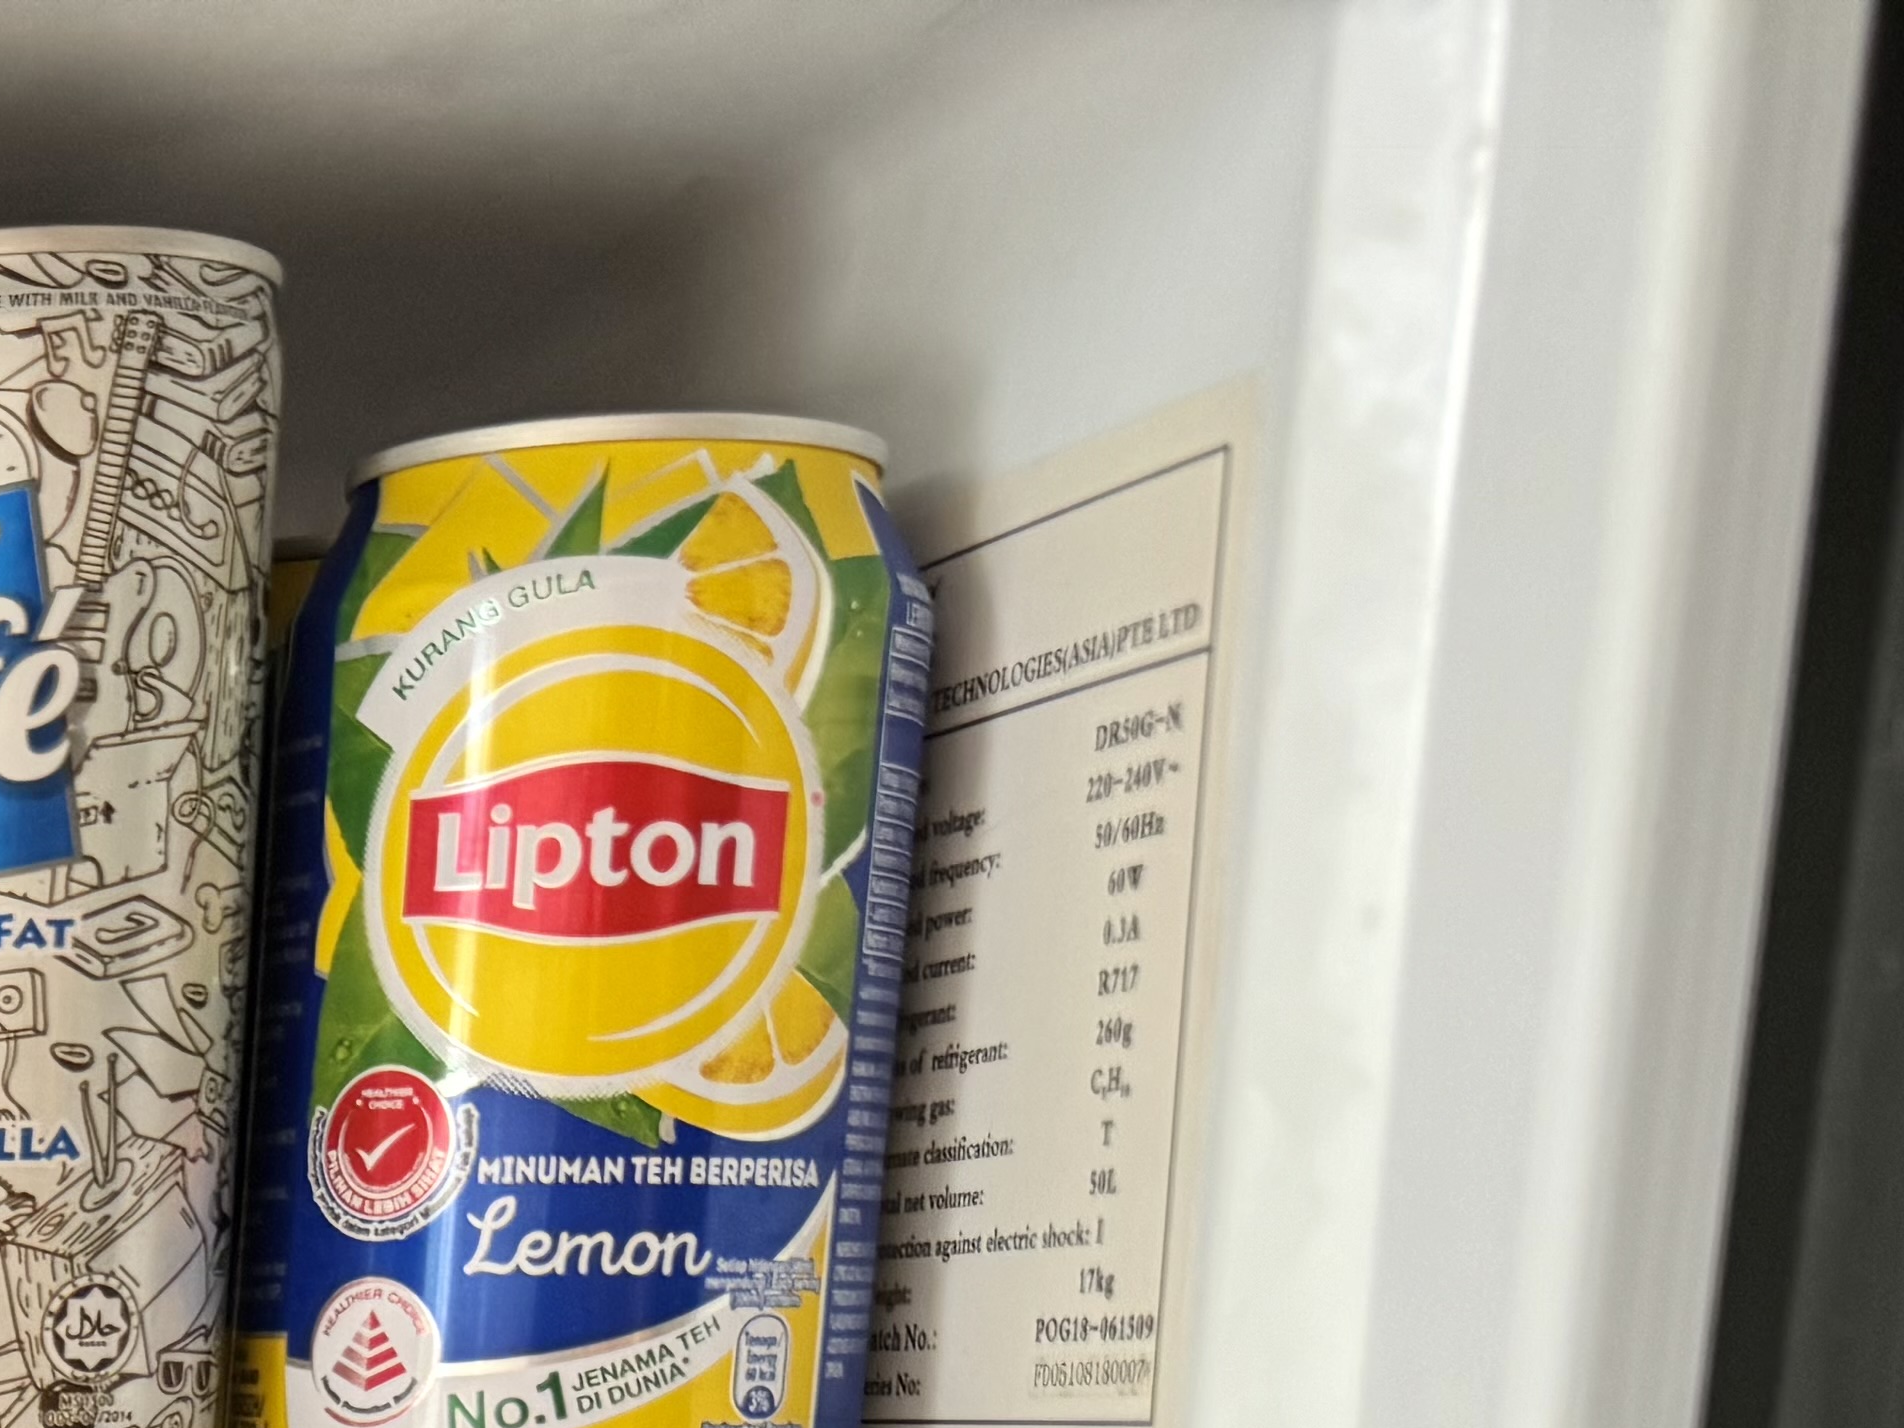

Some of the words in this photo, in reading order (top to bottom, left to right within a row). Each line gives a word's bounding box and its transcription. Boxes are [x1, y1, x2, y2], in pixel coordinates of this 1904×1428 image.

[7, 292, 54, 309] WITH
[58, 290, 98, 307] MILK
[105, 291, 139, 307] AND
[392, 600, 500, 701] KURANG
[507, 569, 596, 608] GULA
[433, 802, 756, 911] Lipton
[1107, 862, 1146, 897] 60W
[1097, 962, 1140, 997] R717
[1095, 1015, 1135, 1050] 260g
[477, 1155, 625, 1186] MINUMAN
[631, 1156, 684, 1185] TEH
[689, 1156, 820, 1189] BERPERISA
[928, 1184, 985, 1211] volume:
[462, 1195, 714, 1279] Lemon
[985, 1224, 1038, 1253] electric
[1041, 1219, 1091, 1248] shock:
[572, 1343, 676, 1392] JENAMA
[676, 1314, 721, 1351] TEH
[576, 1392, 603, 1415] DI
